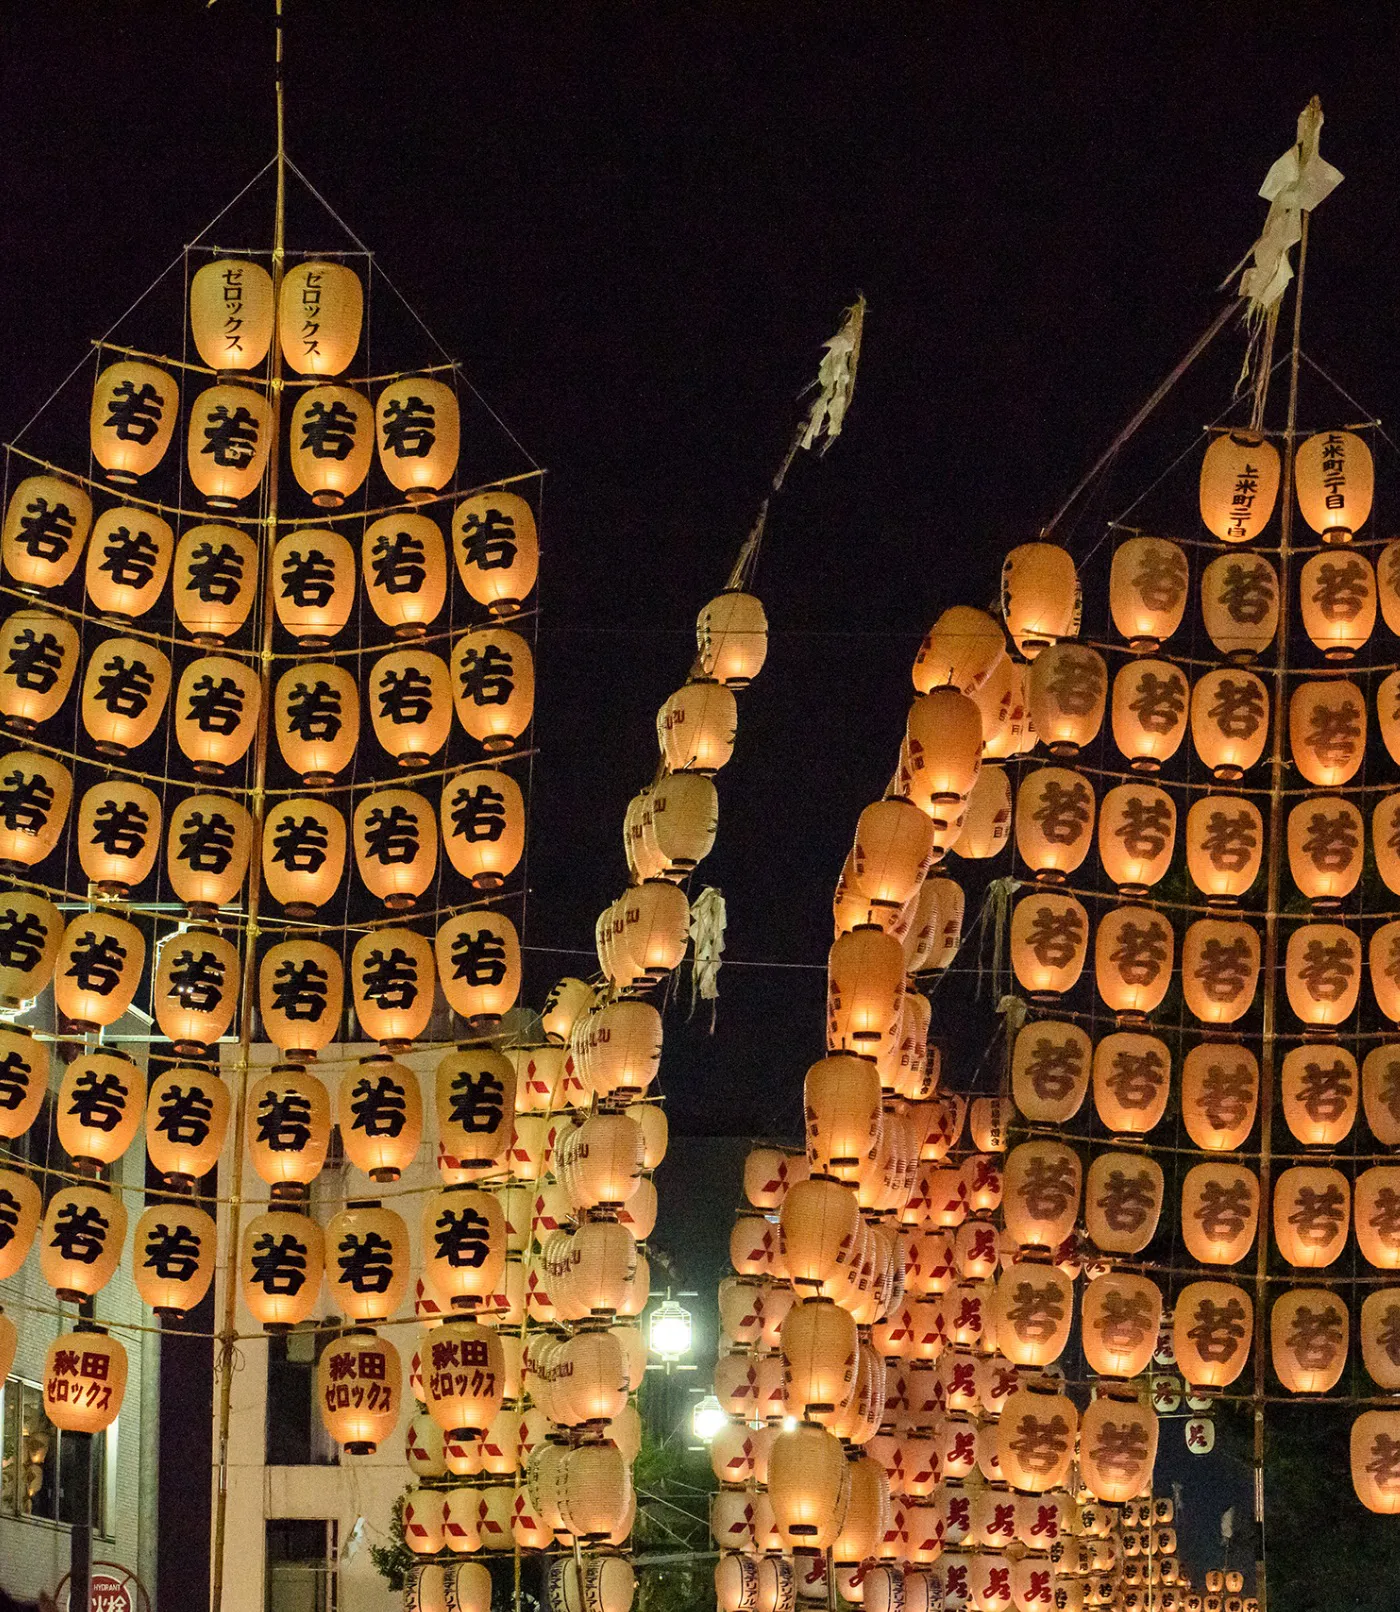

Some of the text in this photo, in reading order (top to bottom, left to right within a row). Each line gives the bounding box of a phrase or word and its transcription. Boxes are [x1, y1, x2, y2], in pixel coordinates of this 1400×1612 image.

[222, 269, 245, 352] ゼロックス
[301, 271, 323, 356] ゼロックス
[105, 380, 164, 445] 若
[204, 406, 259, 469] 若
[300, 402, 358, 461] 若
[383, 397, 435, 458] 若
[1229, 465, 1259, 538] 上米町二丁目
[1322, 434, 1346, 511] 上米町二丁目
[14, 498, 76, 564] 若
[98, 527, 160, 590] 若
[461, 509, 518, 571] 若
[185, 542, 244, 605] 若
[281, 549, 336, 608] 若
[371, 532, 428, 595] 若
[4, 628, 65, 694] 若
[93, 656, 155, 719] 若
[459, 645, 515, 705] 若
[185, 674, 245, 734] 若
[286, 680, 343, 742] 若
[378, 667, 433, 724] 若
[91, 801, 147, 858] 若
[179, 812, 235, 874] 若
[364, 806, 420, 864] 若
[450, 785, 506, 843] 若
[272, 817, 327, 873] 若
[67, 932, 127, 996] 若
[169, 951, 226, 1012] 若
[363, 948, 419, 1010] 若
[451, 930, 508, 986] 若
[271, 960, 328, 1021] 若
[67, 1071, 128, 1133] 若
[154, 1085, 212, 1147] 若
[256, 1090, 312, 1151] 若
[351, 1079, 407, 1137] 若
[449, 1072, 503, 1134] 若
[48, 1203, 109, 1264] 若
[143, 1223, 202, 1282] 若
[337, 1232, 394, 1294] 若
[434, 1208, 490, 1268] 若
[250, 1234, 307, 1295] 若
[52, 1350, 110, 1381] 秋田
[329, 1352, 386, 1381] 秋田
[430, 1369, 496, 1400] ゼロックス
[431, 1341, 488, 1368] 秋田
[47, 1379, 112, 1411] ゼロックス
[325, 1383, 392, 1412] ゼロックス
